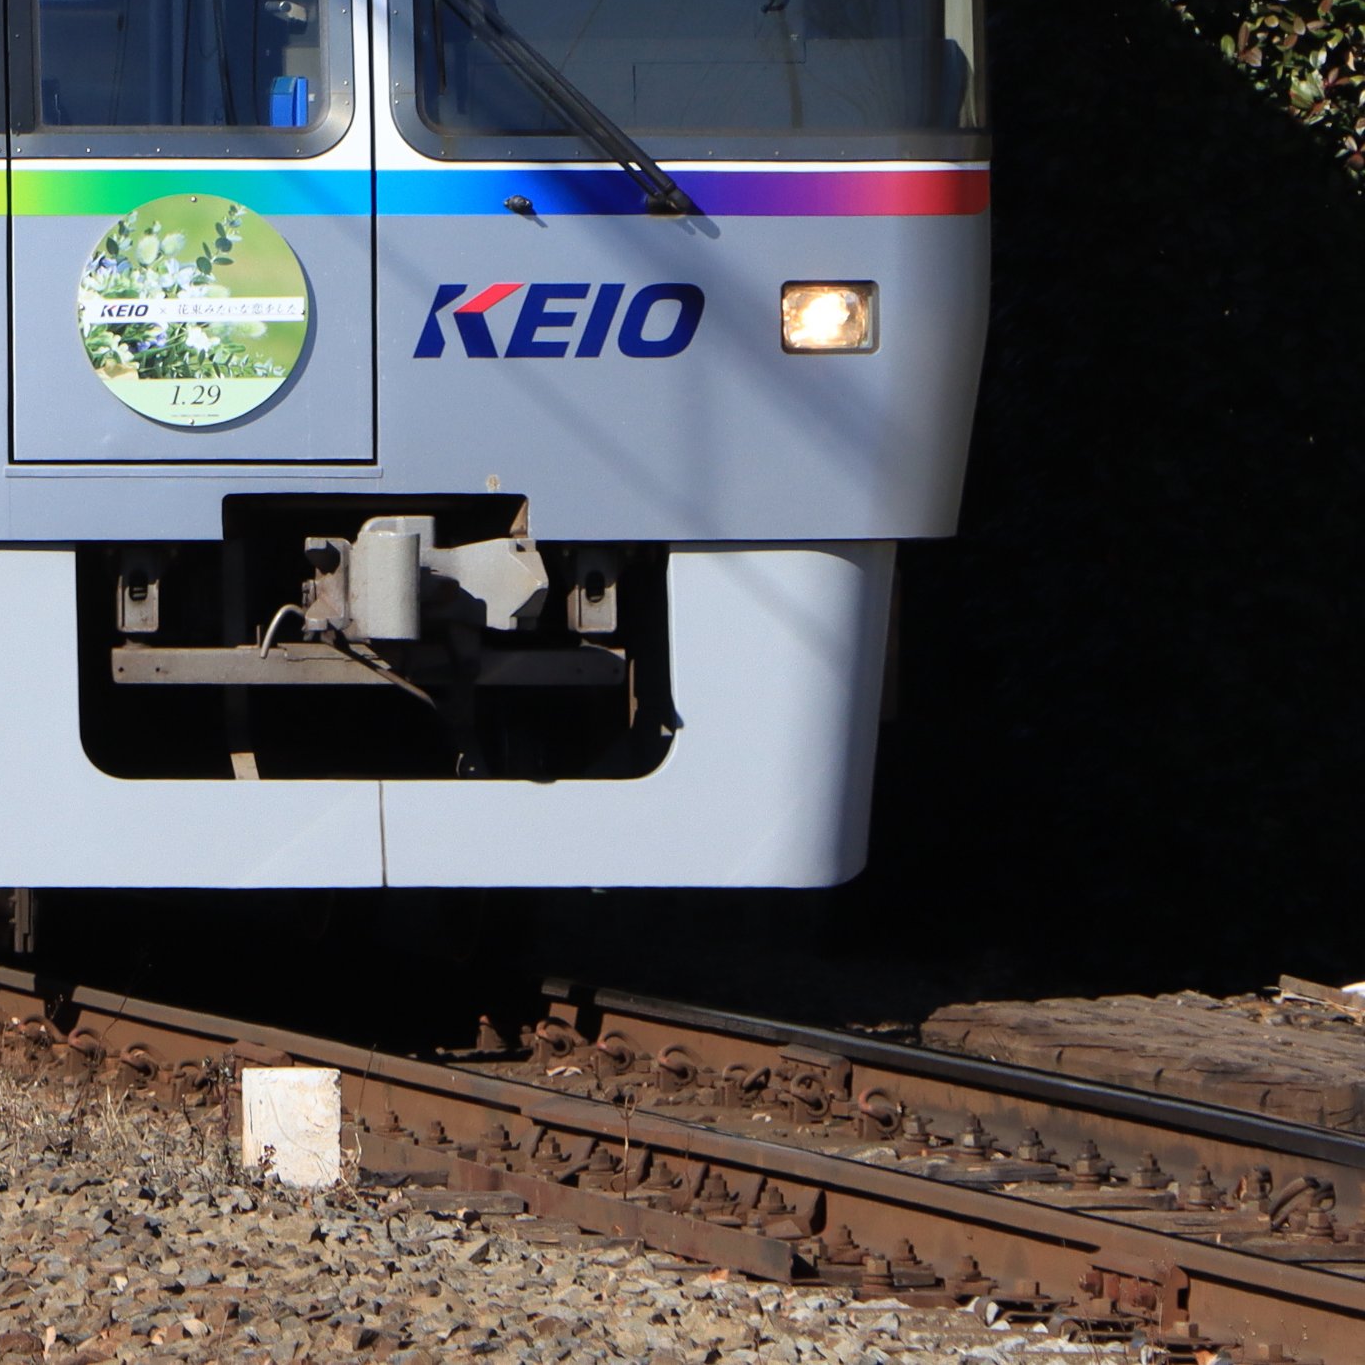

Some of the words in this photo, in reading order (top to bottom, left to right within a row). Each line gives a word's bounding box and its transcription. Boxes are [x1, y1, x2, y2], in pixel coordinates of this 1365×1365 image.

[100, 304, 149, 318] KEIO
[412, 282, 706, 359] KEIO
[170, 384, 222, 406] 1.29
